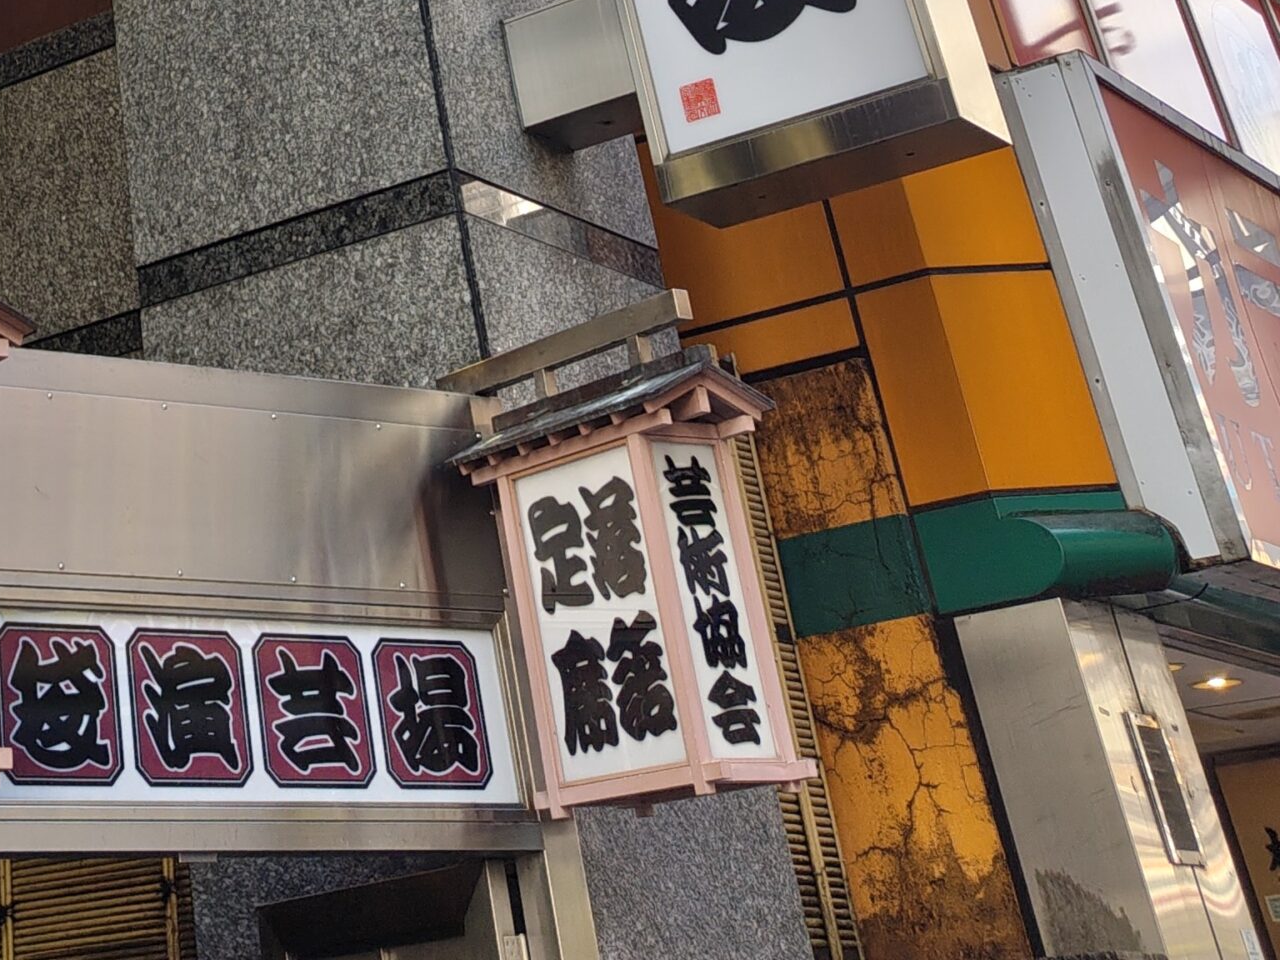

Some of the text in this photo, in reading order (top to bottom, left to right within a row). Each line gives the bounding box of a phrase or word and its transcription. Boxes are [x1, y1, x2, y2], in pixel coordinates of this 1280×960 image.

[10, 638, 480, 775] 袋演芸場
[663, 454, 761, 746] 芸術協会
